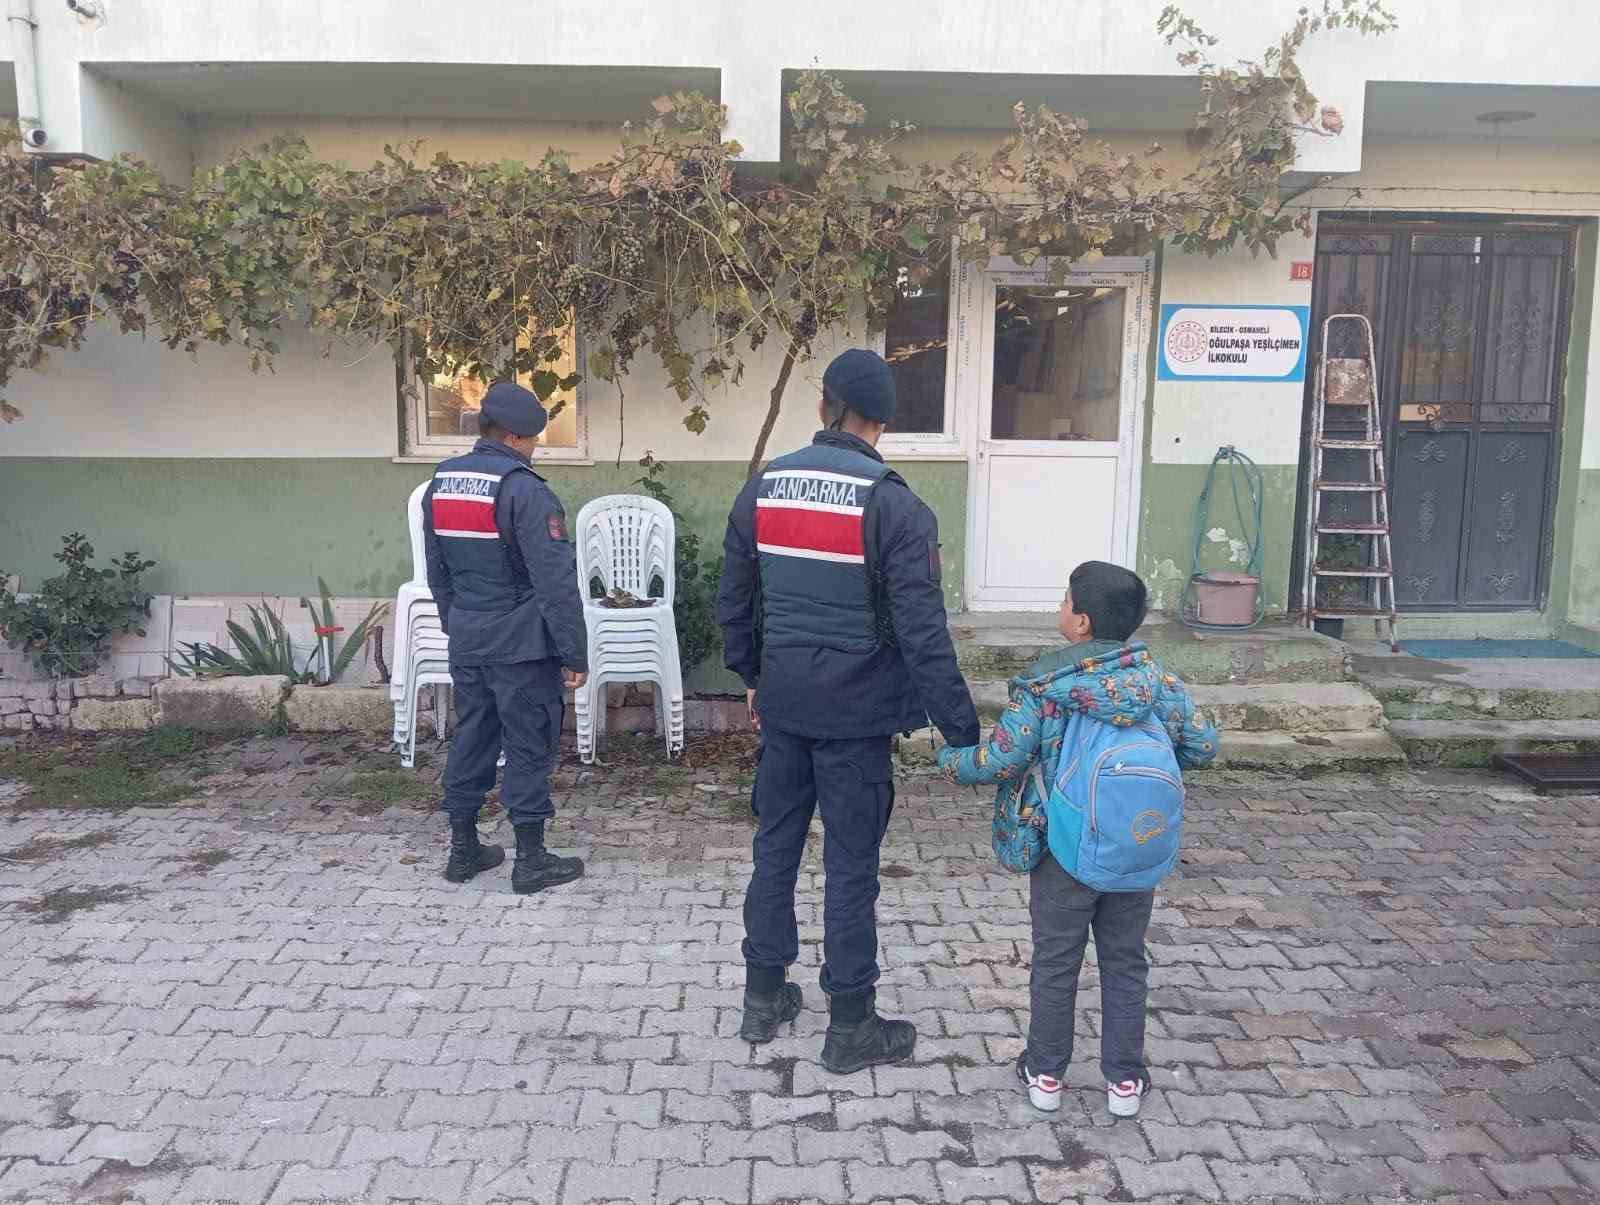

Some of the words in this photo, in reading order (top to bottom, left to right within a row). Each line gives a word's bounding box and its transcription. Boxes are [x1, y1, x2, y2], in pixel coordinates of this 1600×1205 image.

[1297, 265, 1308, 278] 18
[1209, 337, 1250, 351] OĞULPAŞA
[1253, 337, 1300, 352] YEŞİLÇİMEN
[1208, 351, 1248, 363] İLKOKULU
[437, 478, 490, 496] JANDARMA
[768, 478, 857, 506] JANDARMA
